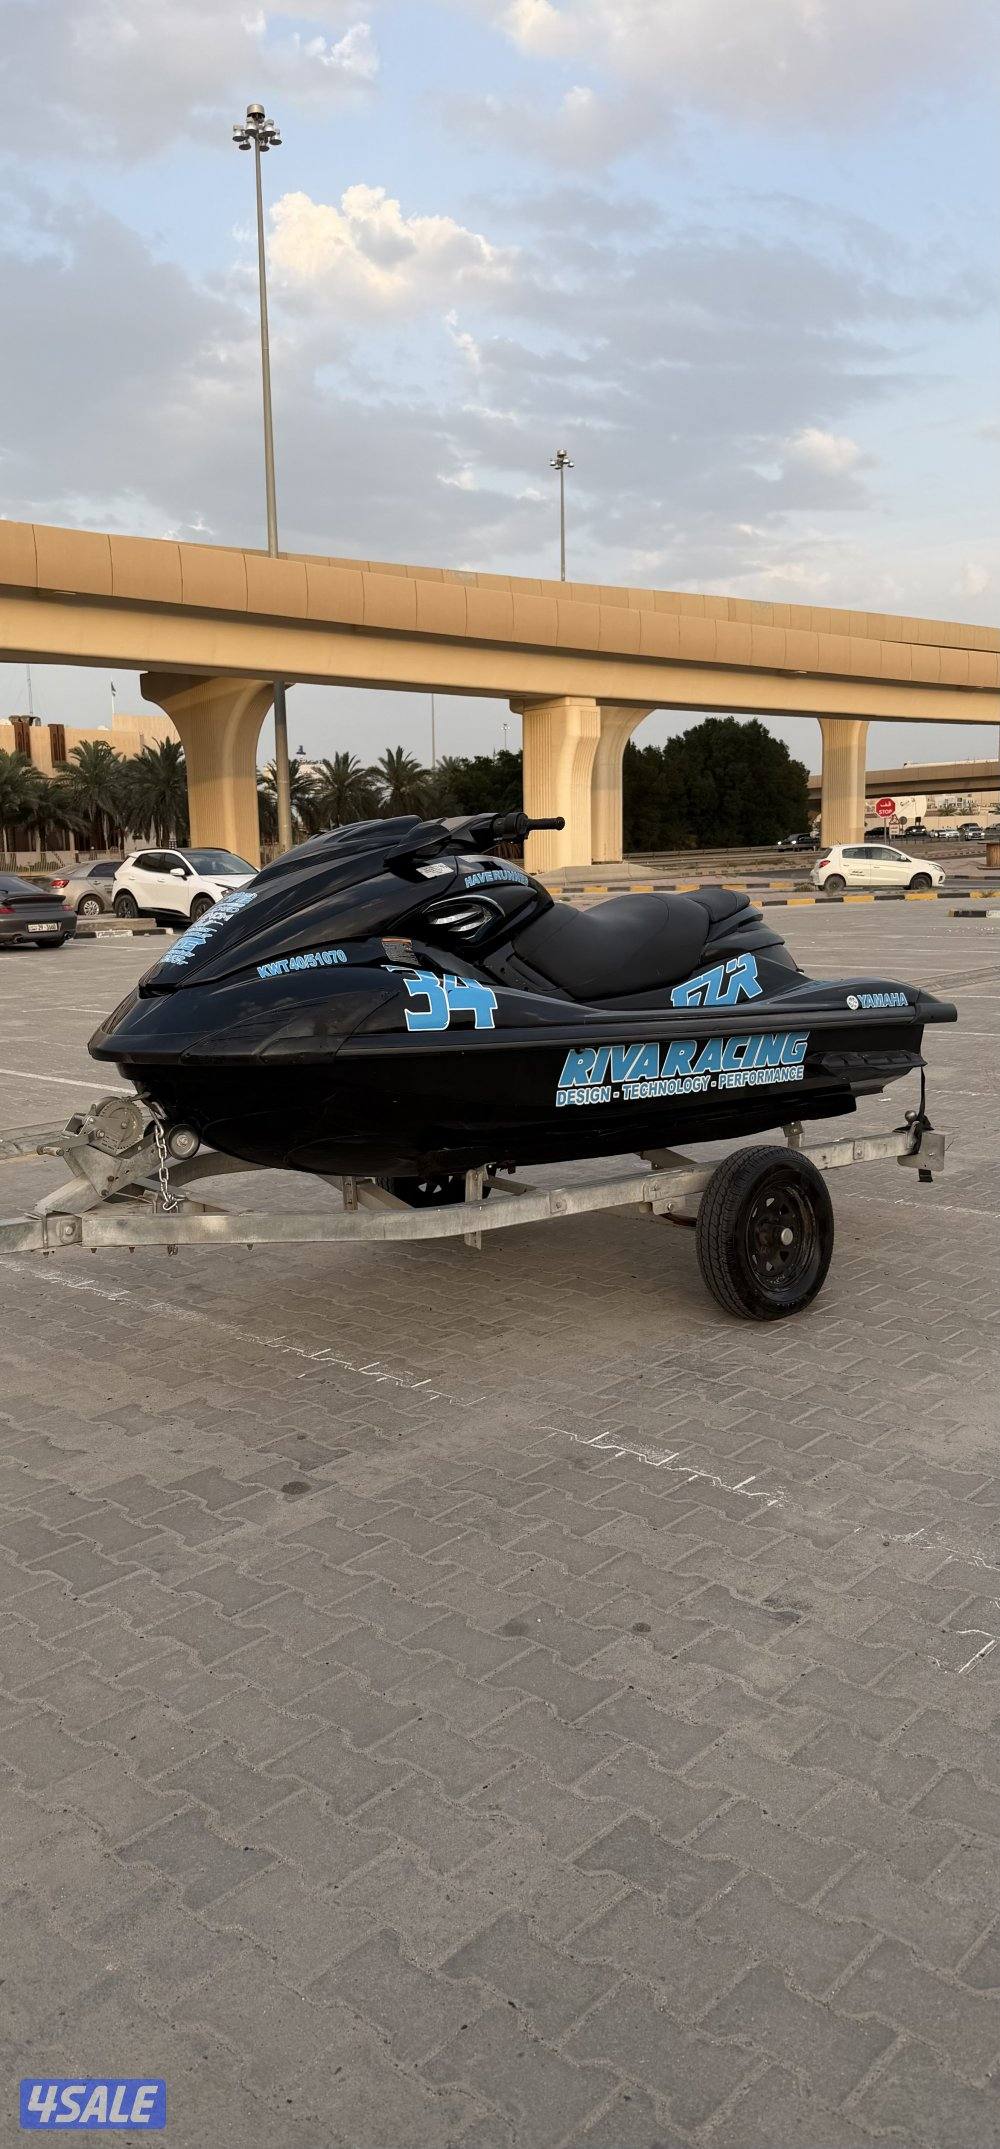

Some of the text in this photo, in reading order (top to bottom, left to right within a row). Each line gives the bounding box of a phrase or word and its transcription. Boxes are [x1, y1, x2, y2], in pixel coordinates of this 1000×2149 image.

[380, 965, 498, 1032] 34
[857, 992, 908, 1009] YAMAHA
[558, 1031, 810, 1088] RIVA RACING
[556, 1086, 611, 1107] DESIGN
[622, 1075, 711, 1101] TECHNOLOGY
[718, 1064, 804, 1090] PERFORMANCE
